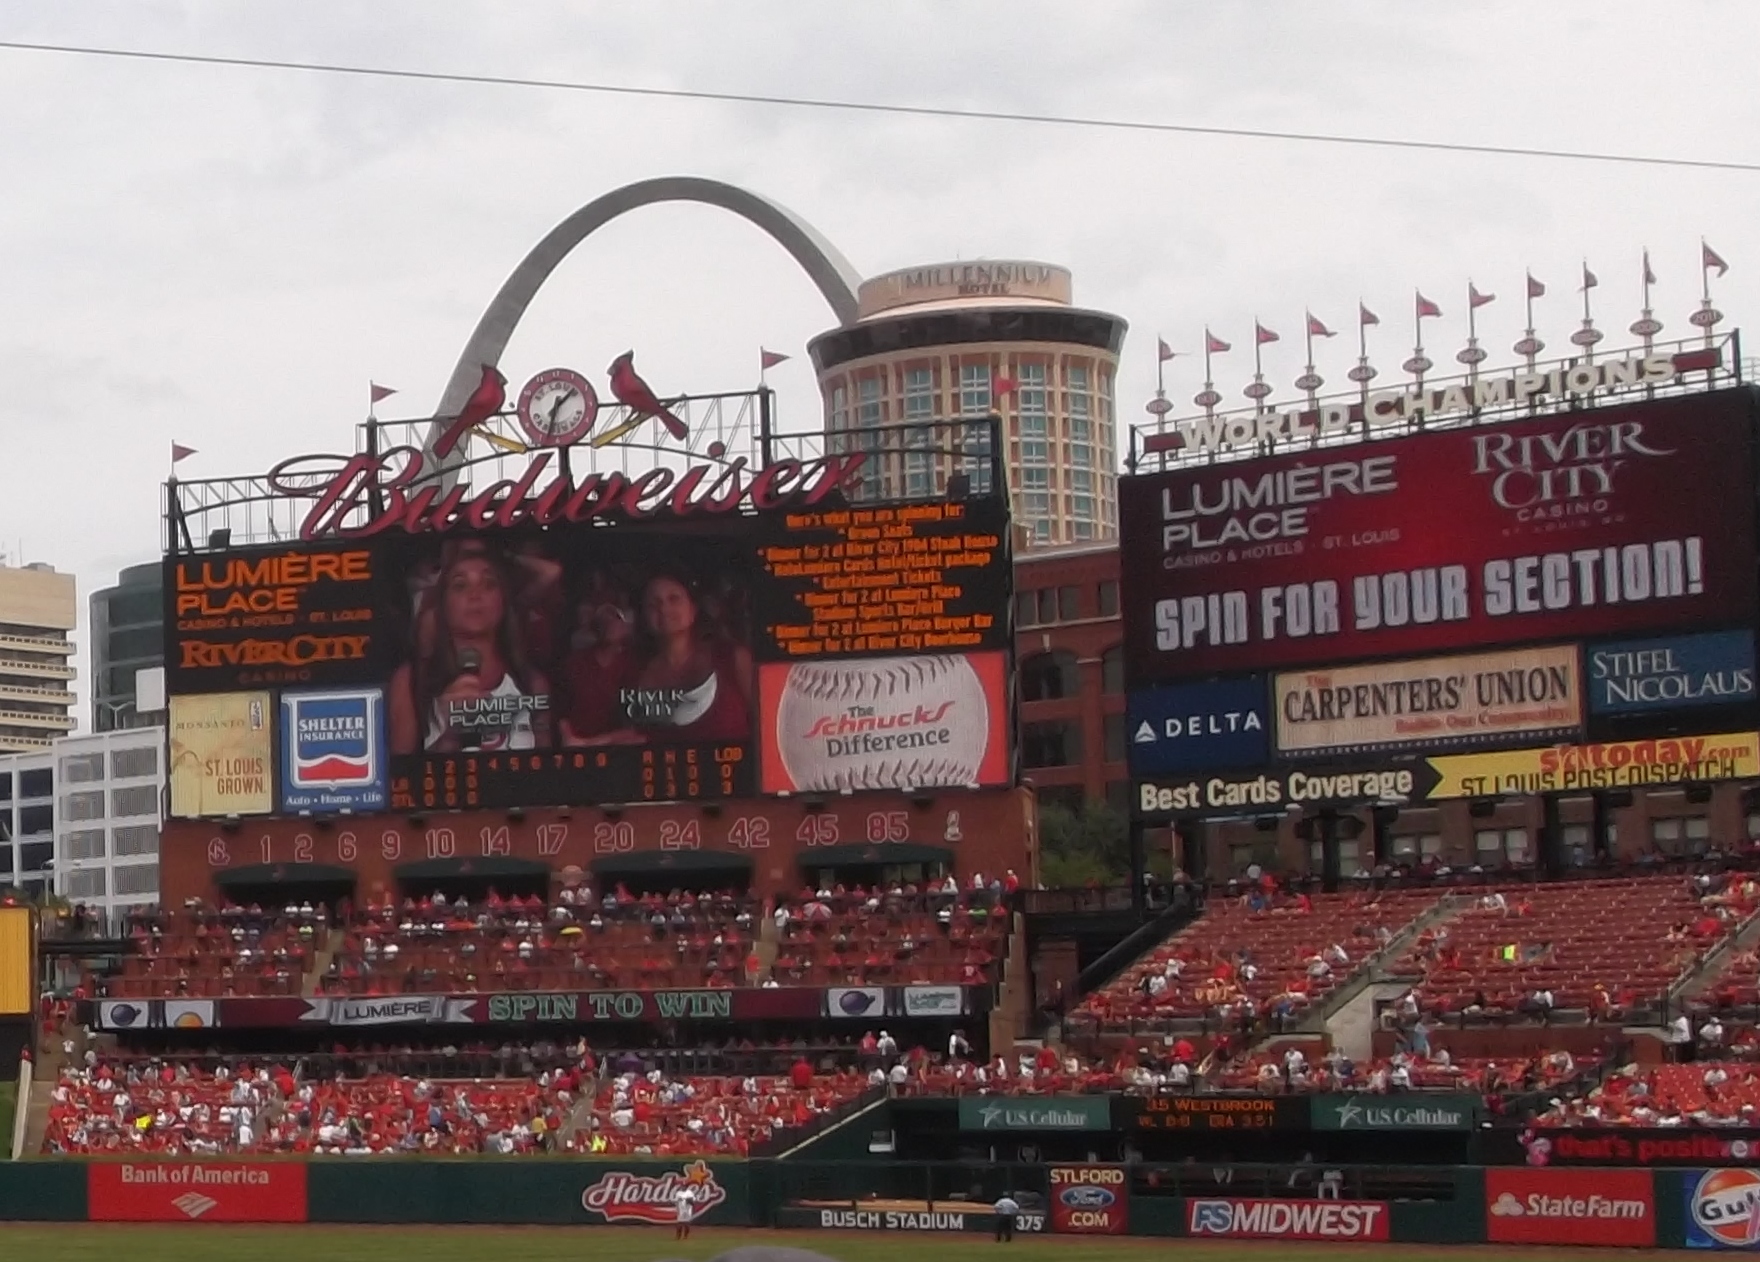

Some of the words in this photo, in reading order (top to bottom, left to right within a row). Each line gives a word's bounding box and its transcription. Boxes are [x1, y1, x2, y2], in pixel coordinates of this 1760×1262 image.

[1176, 403, 1349, 452] WORLD
[1364, 352, 1677, 426] CHAMPIONS
[1470, 421, 1678, 475] RIVER
[268, 445, 867, 541] Budweiser
[1161, 455, 1399, 521] LUMIÈRE
[1493, 459, 1627, 509] CITY
[1516, 498, 1609, 522] CASINO
[1162, 506, 1309, 551] PLACE
[1163, 551, 1220, 570] CASINO
[1226, 549, 1237, 563] &
[1242, 540, 1304, 559] HOTELS
[1352, 527, 1400, 547] LOUIS
[177, 550, 371, 591] LUMIÈRE
[177, 586, 298, 617] PLACE
[1155, 590, 1249, 651] SPIN
[1260, 579, 1340, 640] FOR
[1353, 563, 1469, 631] YOUR
[1484, 535, 1705, 616] SECTION!
[1593, 649, 1681, 680] STIFEL
[620, 687, 685, 704] RIVER
[1283, 672, 1467, 723] CARPENTERS'
[1476, 664, 1568, 707] UNION
[1606, 667, 1754, 704] NICOLAUS
[299, 717, 365, 732] SHELTER
[450, 713, 513, 727] PLACE
[803, 701, 956, 739] Schnucks
[847, 704, 874, 718] The
[1165, 710, 1262, 738] DELTA
[299, 731, 365, 742] INSURANCE
[827, 725, 950, 758] Difference
[205, 758, 224, 776] ST.
[226, 757, 264, 776] LOUIS
[1563, 759, 1736, 789] POST-DISPATCH
[286, 796, 311, 806] Auto
[321, 794, 352, 805] Home
[363, 792, 383, 803] Life
[1140, 781, 1200, 812] Best
[1206, 775, 1281, 807] Cards
[1288, 768, 1414, 801] Coverage
[260, 834, 271, 864] 1
[294, 833, 313, 864] 2
[338, 831, 357, 862] 6
[381, 830, 401, 860] 9
[425, 827, 455, 859] 10
[479, 825, 511, 857] 14
[536, 824, 568, 856] 17
[594, 820, 634, 854] 20
[660, 818, 701, 851] 24
[728, 816, 770, 849] 42
[797, 813, 839, 847] 45
[866, 811, 910, 844] 85
[488, 994, 579, 1021] SPIN
[590, 993, 644, 1019] TO
[655, 991, 733, 1018] WIN
[1029, 1109, 1087, 1126] Cellular
[1393, 1106, 1462, 1126] Cellular
[121, 1164, 168, 1183] Bank
[170, 1164, 190, 1183] of
[191, 1165, 269, 1184] America
[1050, 1168, 1125, 1185] STLFORD
[820, 1209, 881, 1229] BUSCH
[885, 1210, 964, 1231] STADIUM
